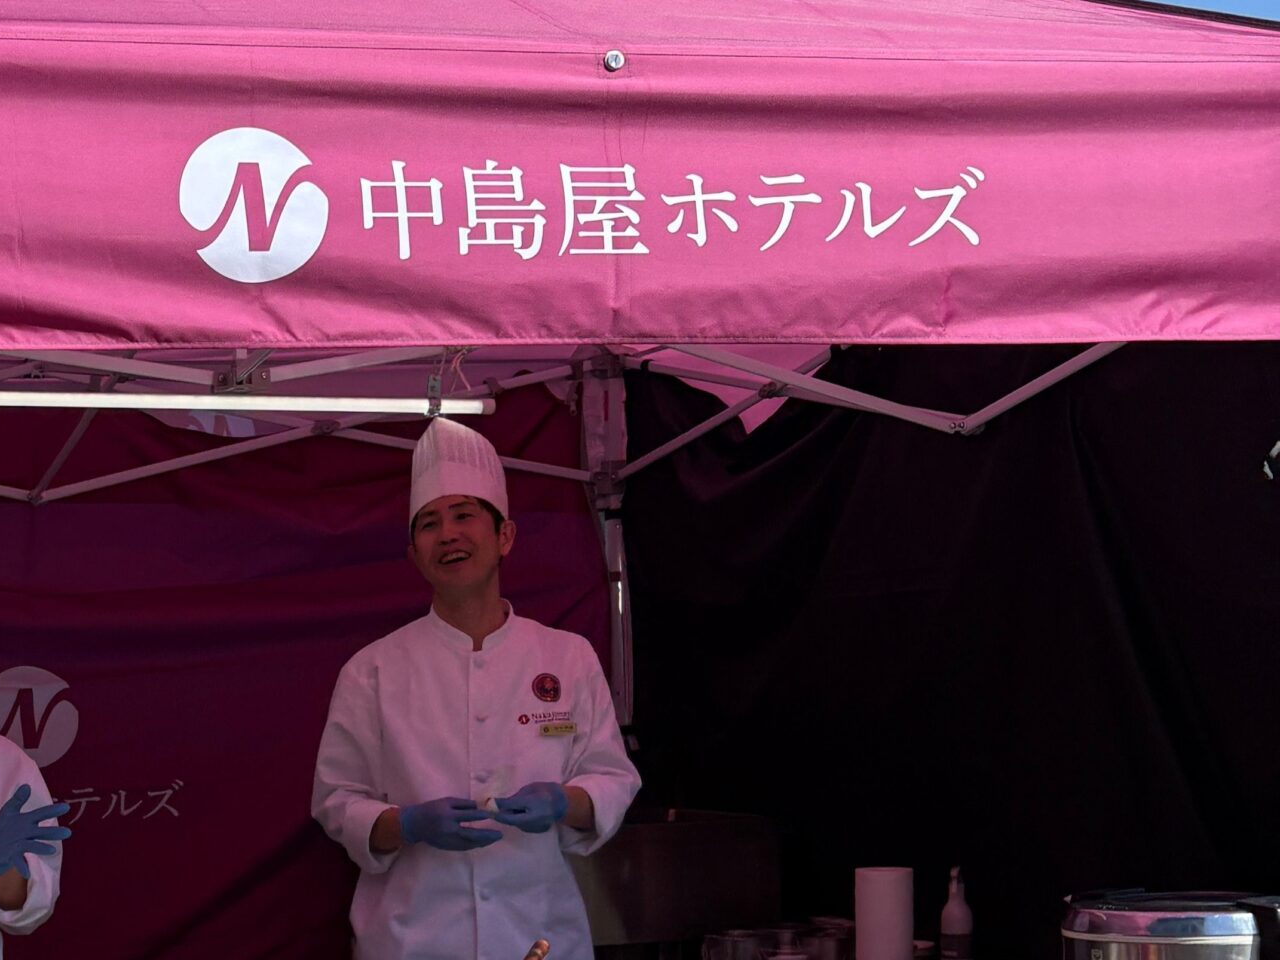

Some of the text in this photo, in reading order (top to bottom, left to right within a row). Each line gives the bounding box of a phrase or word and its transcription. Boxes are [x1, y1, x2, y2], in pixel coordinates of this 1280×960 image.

[359, 160, 986, 261] 中島屋ホテルズ
[53, 779, 184, 825] テルズ
